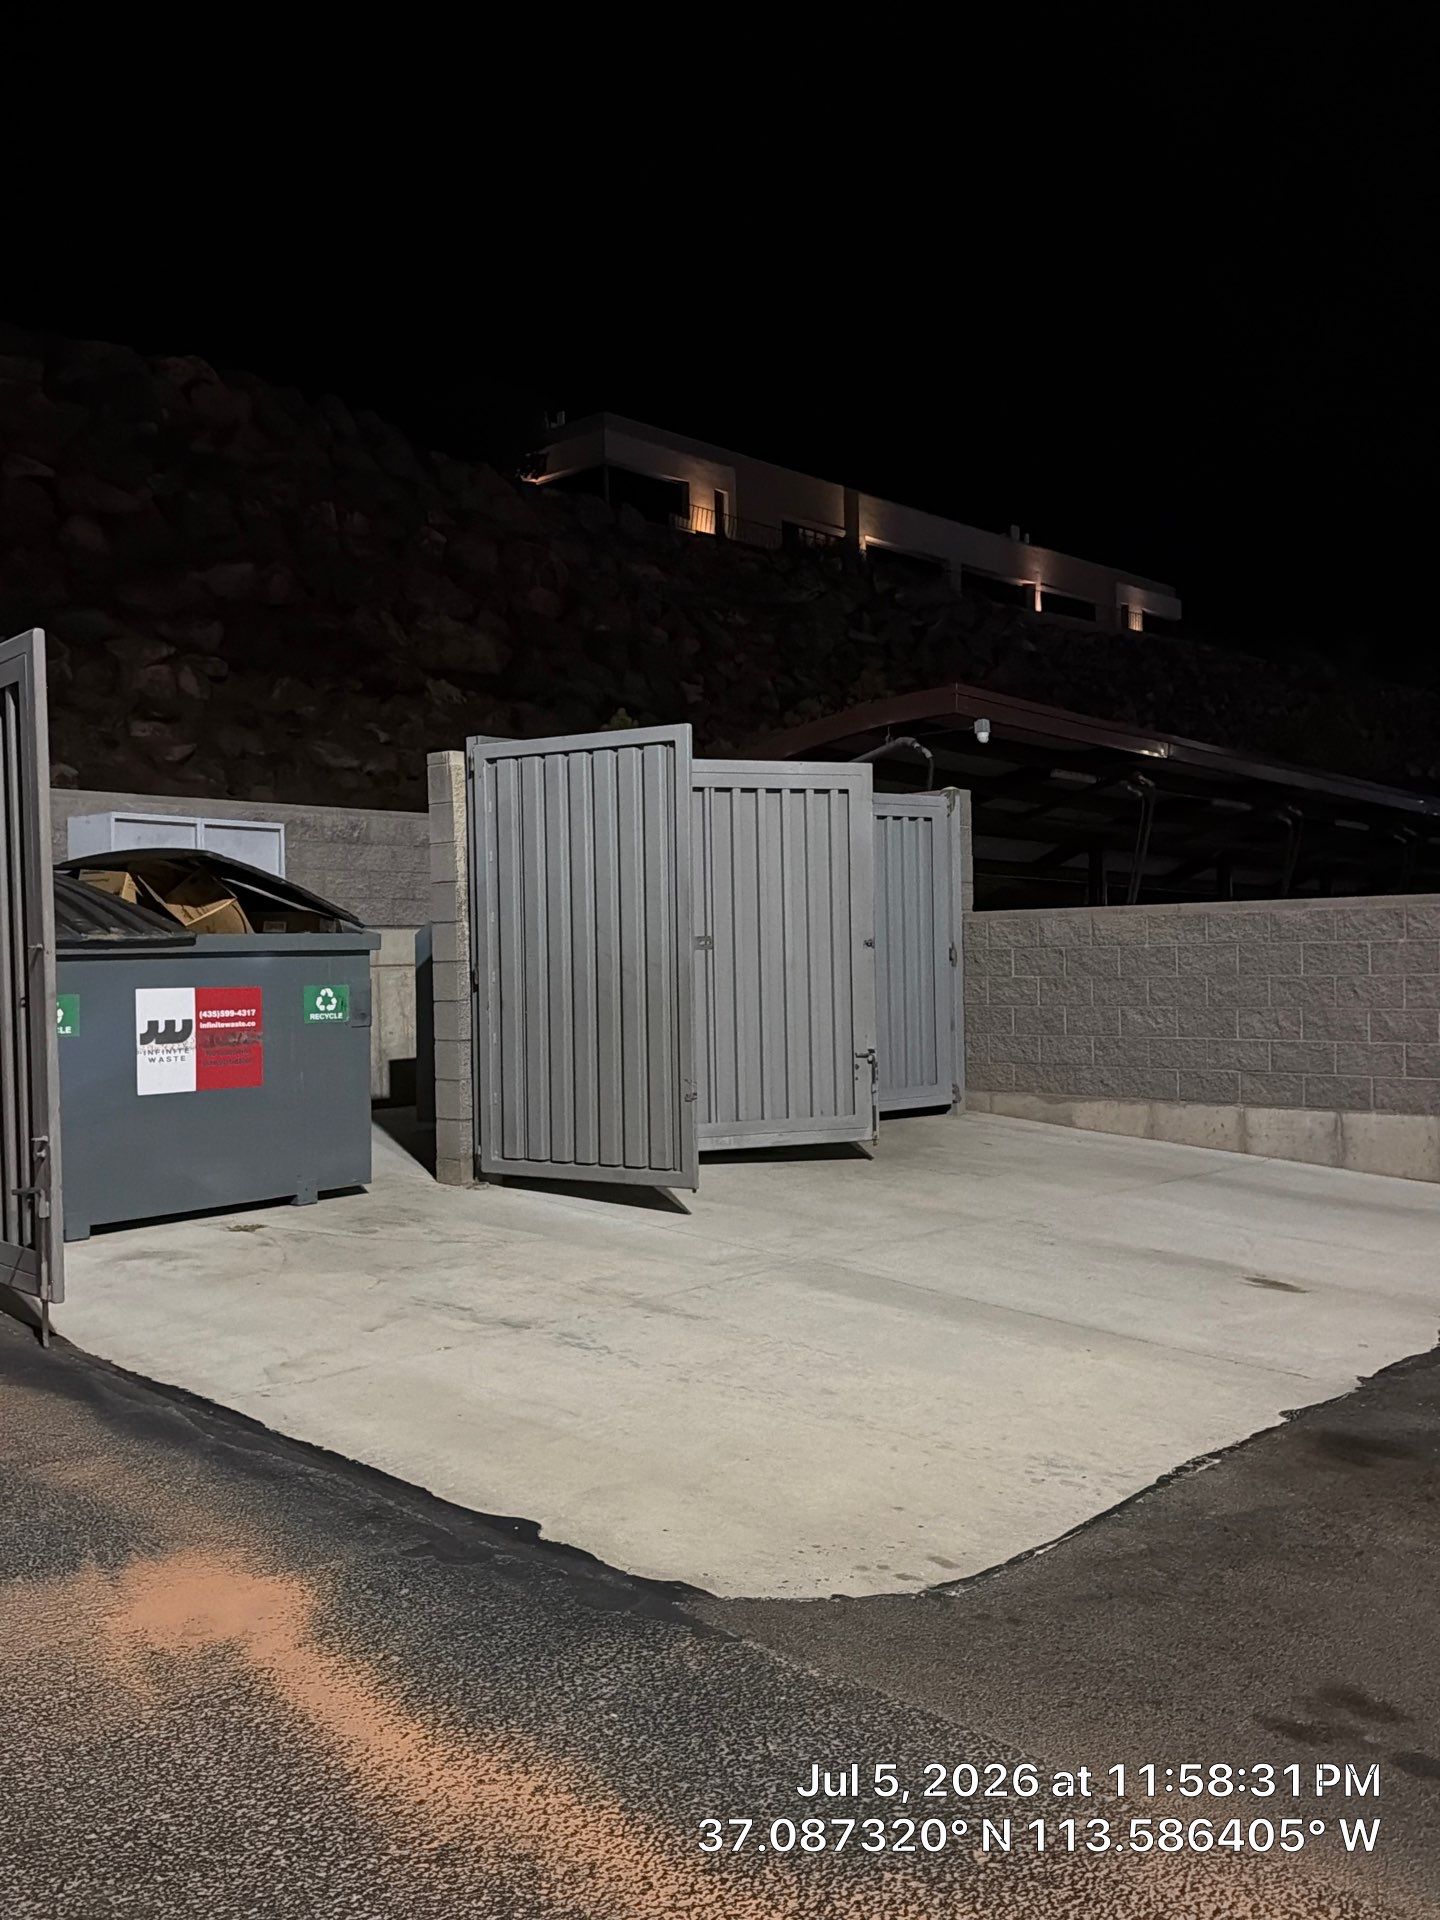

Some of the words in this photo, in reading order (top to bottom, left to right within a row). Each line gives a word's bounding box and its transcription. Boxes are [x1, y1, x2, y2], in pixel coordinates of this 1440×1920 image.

[310, 1012, 343, 1020] RECYCLE
[143, 1047, 190, 1055] INFINITE
[148, 1055, 186, 1063] WASTE
